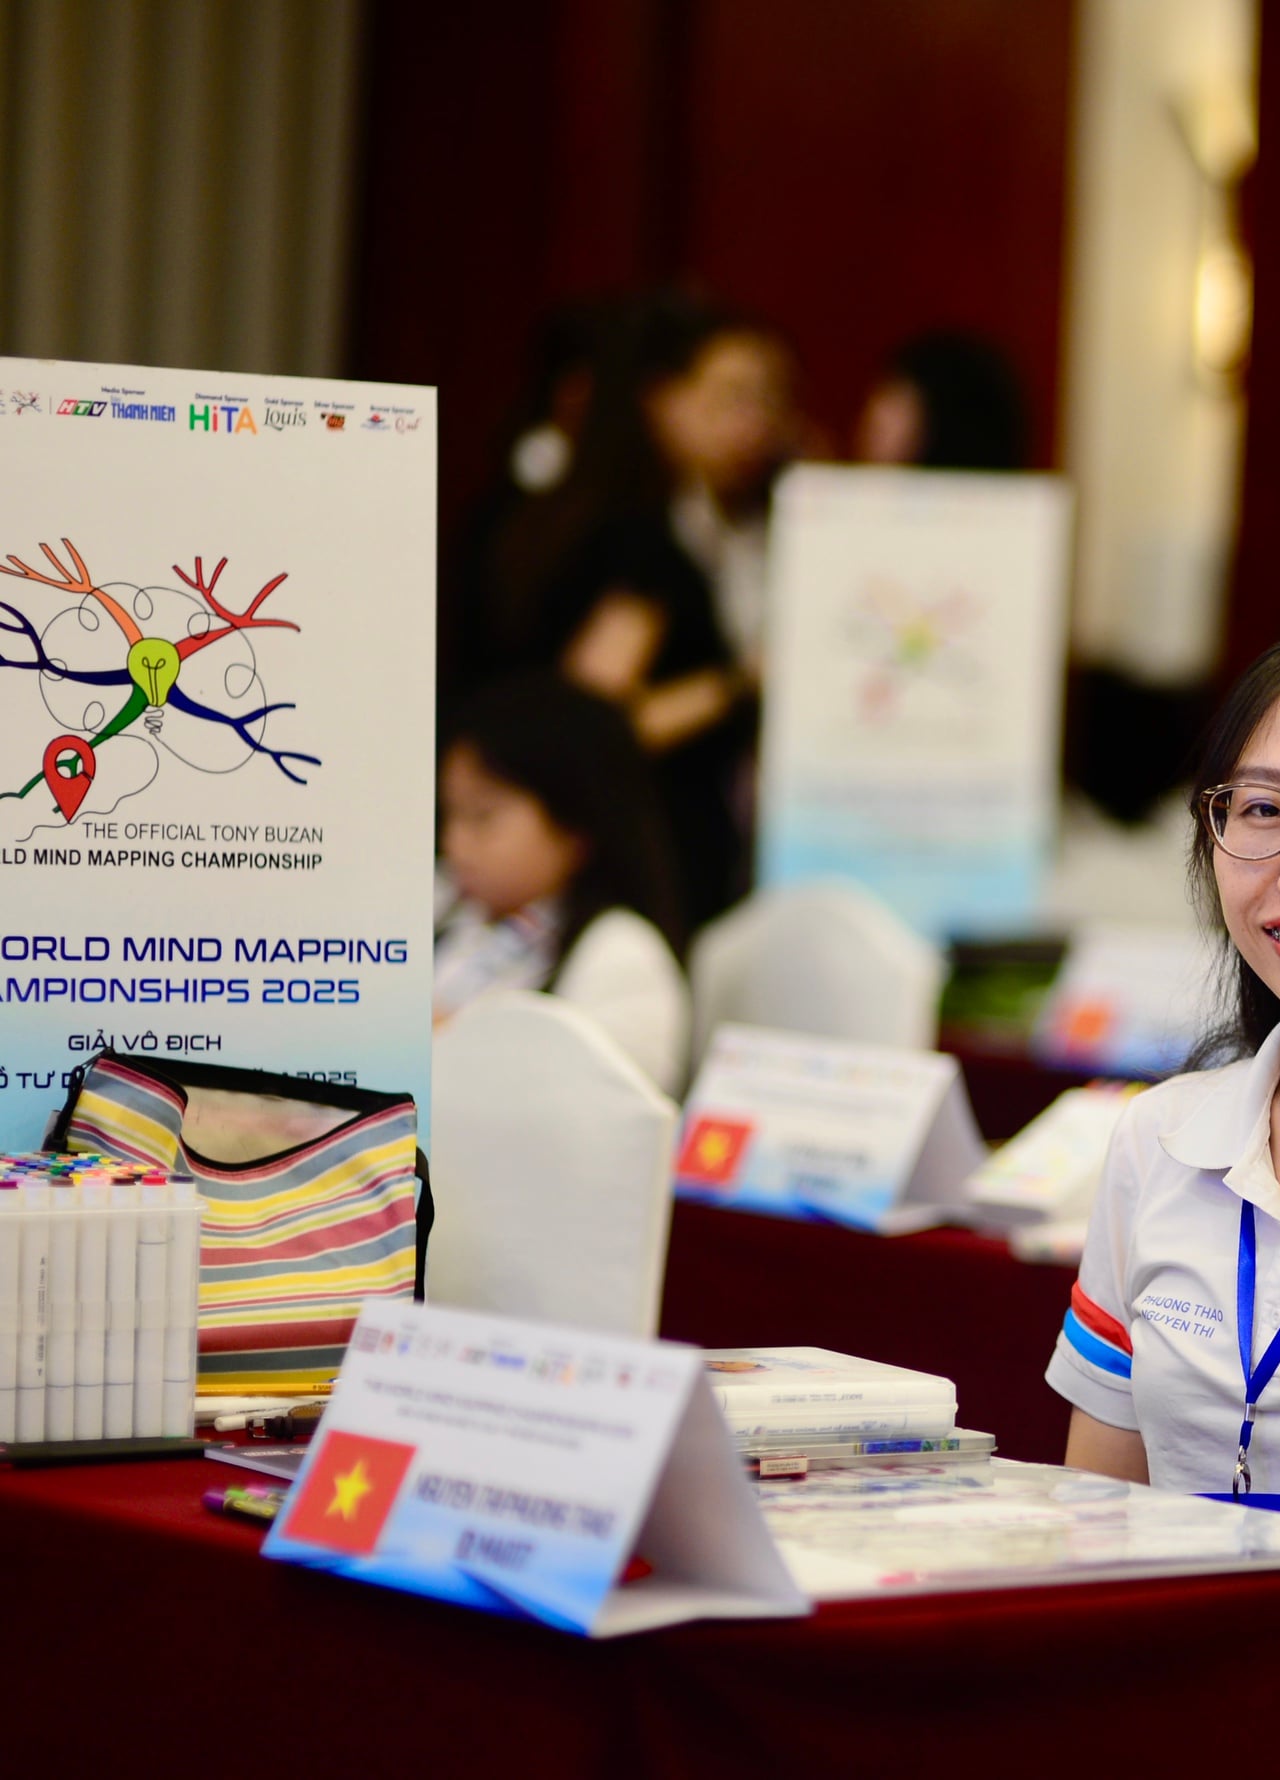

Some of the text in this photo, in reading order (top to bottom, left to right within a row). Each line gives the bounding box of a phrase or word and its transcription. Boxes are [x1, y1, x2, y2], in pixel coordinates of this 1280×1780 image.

[57, 399, 107, 417] HTV
[111, 401, 149, 421] THANH
[189, 404, 257, 435] HiTA
[82, 822, 324, 844] THE OFFICIAL TONY BUZAN
[0, 848, 323, 870] LD MIND MAPPING CHAMPIONSHIP
[123, 938, 222, 962] MIND
[235, 939, 408, 963] MAPPING
[0, 977, 360, 1003] MPIONSHIPS 2025
[122, 1031, 158, 1051] VÔ
[166, 1034, 222, 1055] ĐỊCH
[16, 1070, 55, 1089] TƯ
[1142, 1296, 1224, 1322] PHUONG THAO
[1141, 1309, 1216, 1338] NGUYEN THI
